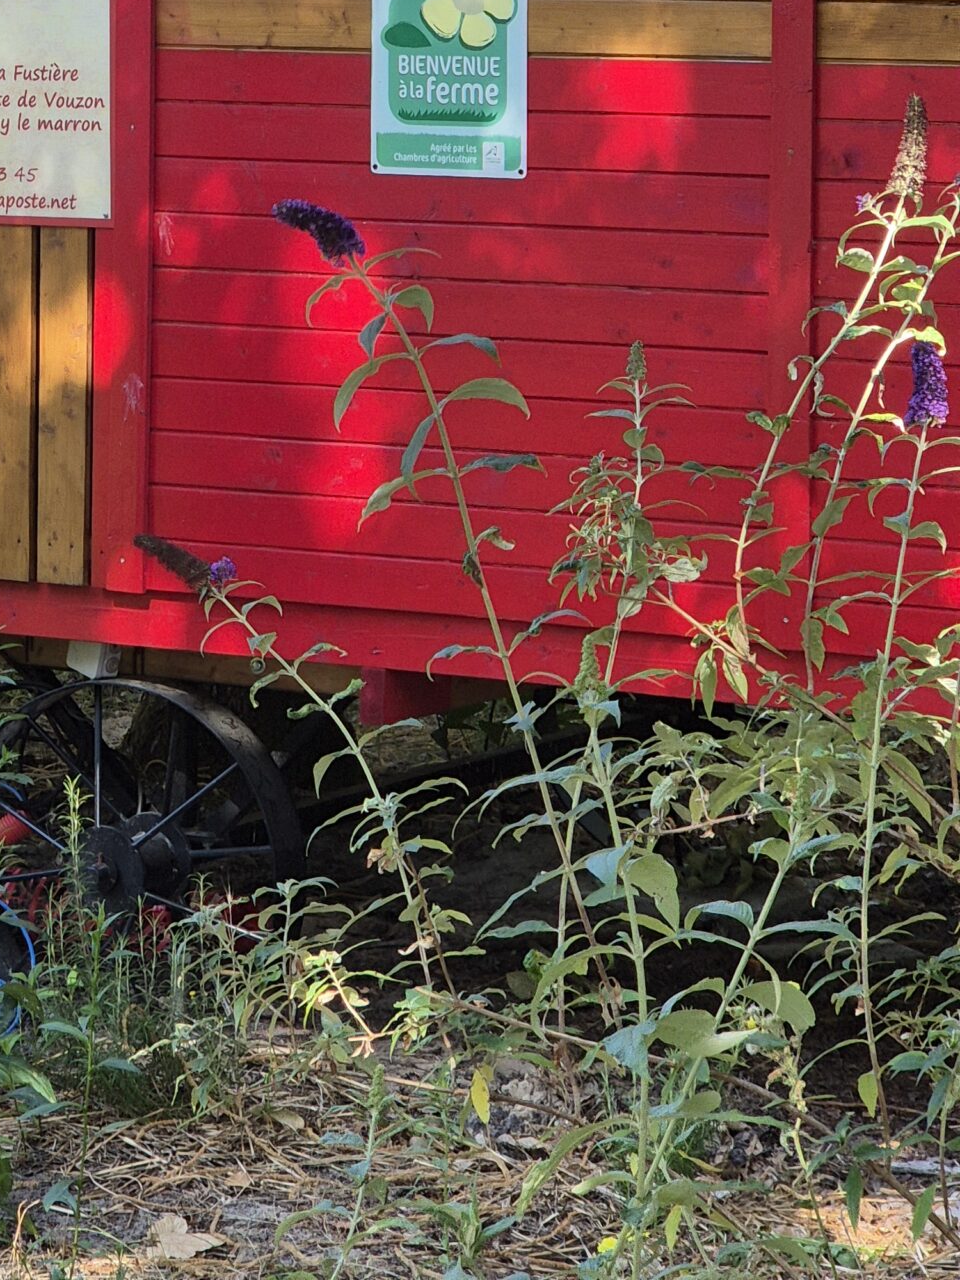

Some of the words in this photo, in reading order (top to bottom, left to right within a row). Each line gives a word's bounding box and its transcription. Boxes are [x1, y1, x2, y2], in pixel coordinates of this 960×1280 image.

[13, 63, 79, 82] Fustière
[398, 54, 501, 77] BIENVENUE
[17, 90, 37, 108] de
[44, 92, 105, 109] Vouzon
[399, 80, 408, 98] à
[410, 81, 423, 99] la
[426, 76, 499, 104] ferme
[17, 113, 30, 131] le
[38, 118, 102, 132] marron
[393, 152, 429, 162] Chambres
[430, 143, 451, 154] Agréé
[453, 145, 464, 154] par
[466, 144, 477, 153] les
[14, 167, 38, 182] 45
